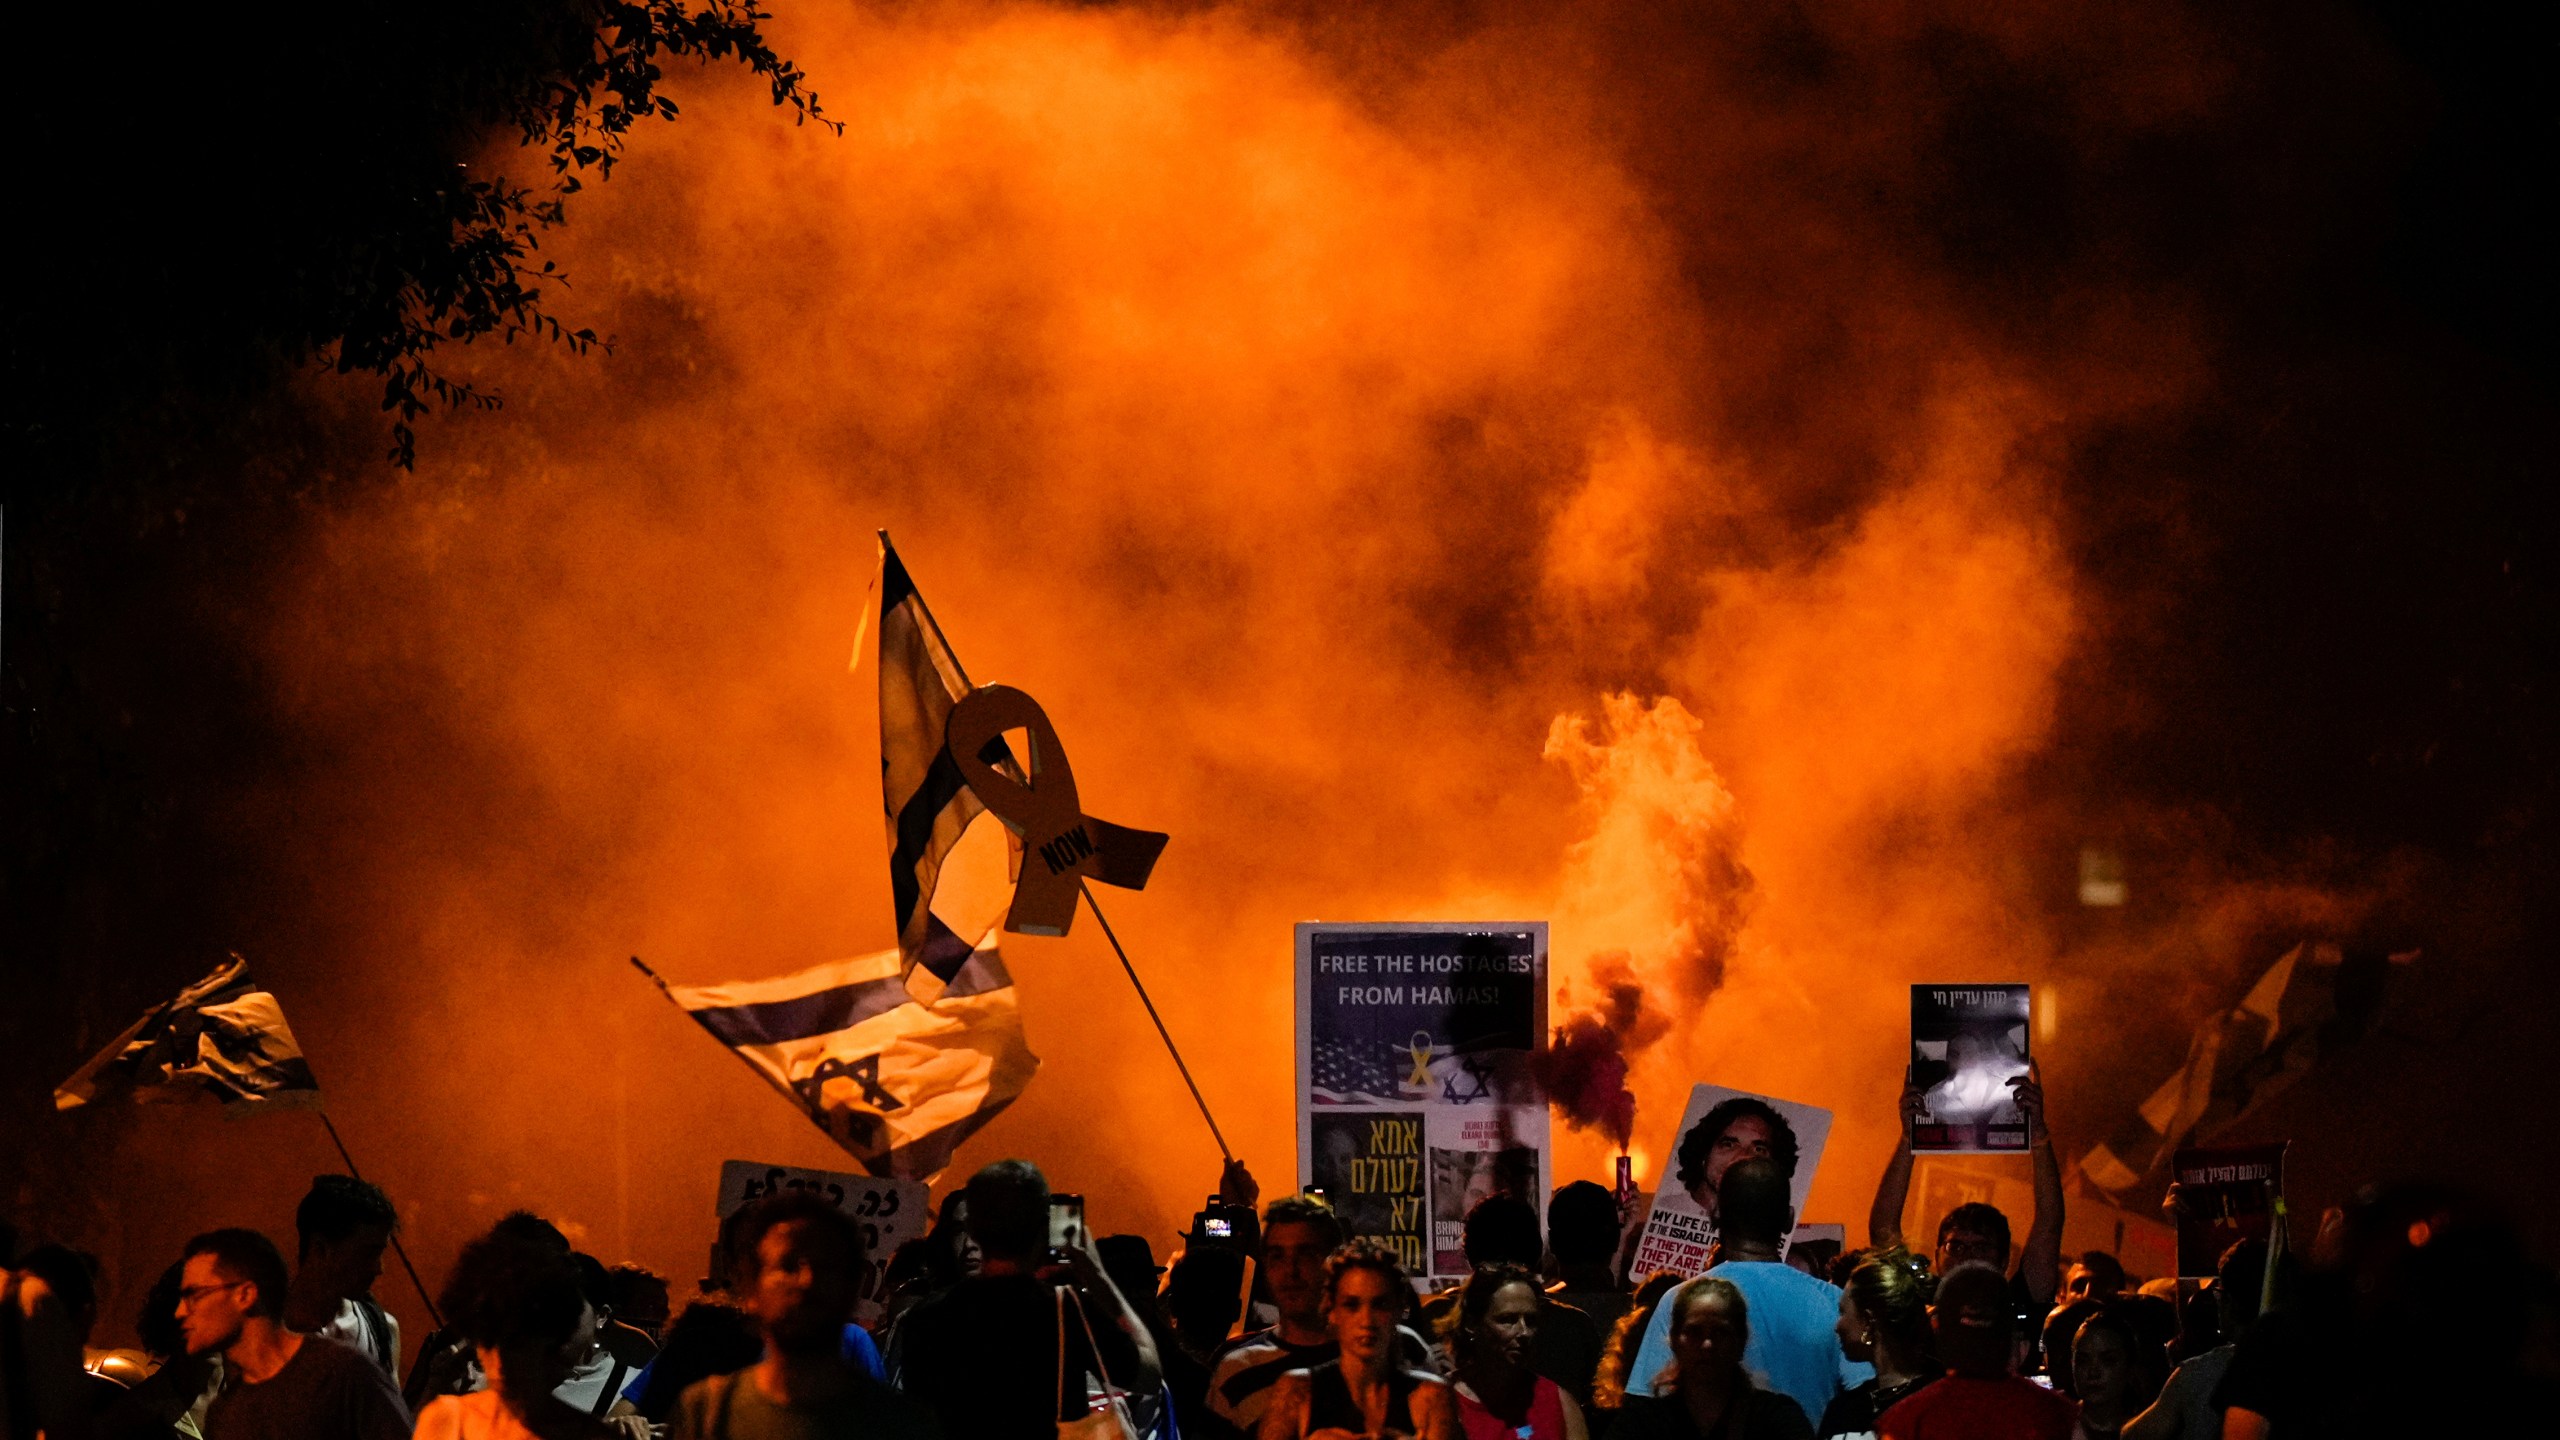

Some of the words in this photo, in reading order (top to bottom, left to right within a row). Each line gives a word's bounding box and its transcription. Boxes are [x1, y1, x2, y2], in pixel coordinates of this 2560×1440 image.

[1320, 955, 1368, 973] FREE
[1374, 955, 1414, 973] THE
[1420, 955, 1530, 973] HOSTAGES
[1338, 986, 1403, 1005] FROM
[1411, 986, 1499, 1005] HAMAS!
[1932, 990, 1947, 1006] חי
[1949, 990, 1980, 1008] עדיין
[1370, 1119, 1418, 1155] אמא
[1351, 1155, 1418, 1193] לעולם
[1390, 1194, 1420, 1231] לא
[1652, 1210, 1672, 1223] MY
[1672, 1214, 1700, 1230] LIFE
[1700, 1220, 1710, 1232] IS
[1643, 1235, 1655, 1246] IF
[1656, 1238, 1683, 1253] THEY
[1648, 1222, 1658, 1233] OF
[1657, 1224, 1670, 1235] THE
[1669, 1227, 1710, 1245] ISRAELI
[1641, 1247, 1673, 1264] THEY
[1674, 1255, 1702, 1271] ARE
